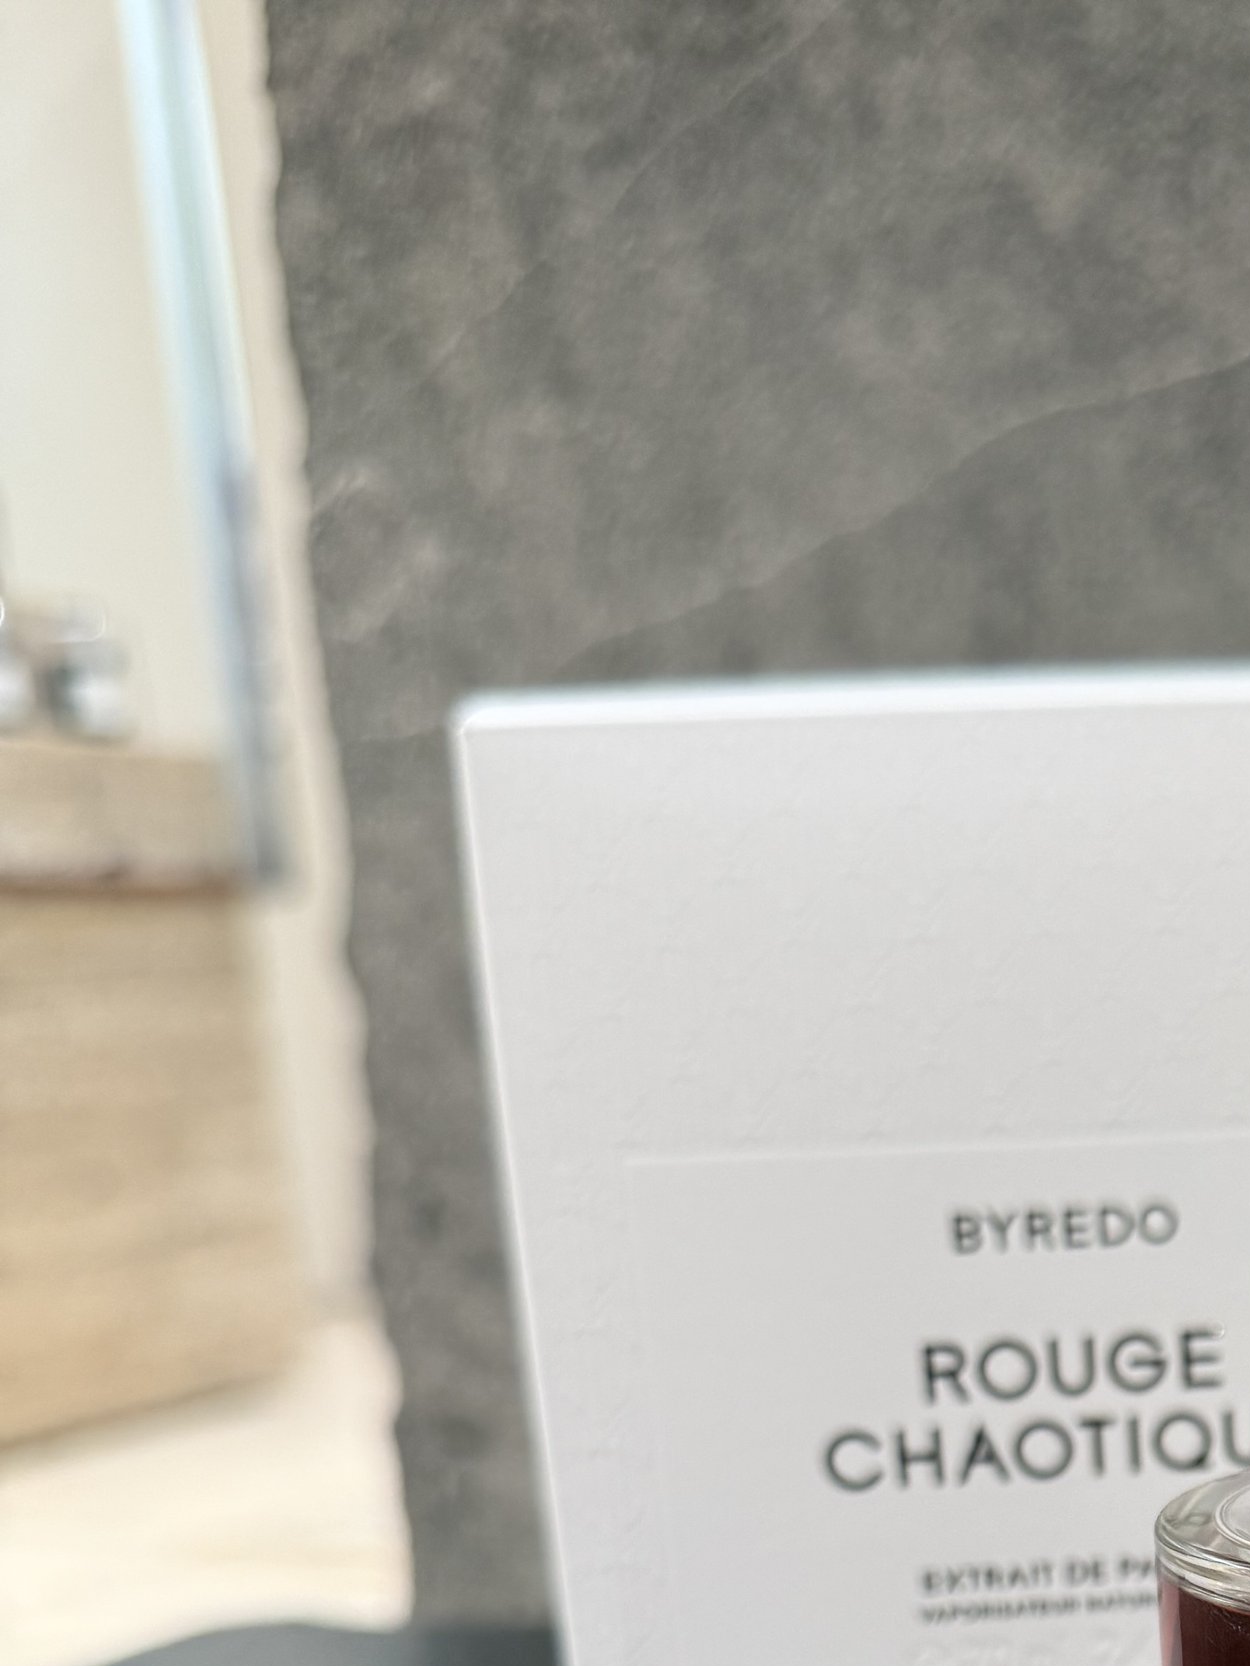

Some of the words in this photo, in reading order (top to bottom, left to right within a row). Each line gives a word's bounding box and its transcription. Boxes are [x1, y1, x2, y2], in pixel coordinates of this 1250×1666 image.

[950, 1203, 1178, 1254] BYREDO
[920, 1326, 1226, 1404] ROUGE
[920, 1560, 1053, 1593] EXTRAIT
[1062, 1557, 1105, 1586] DE
